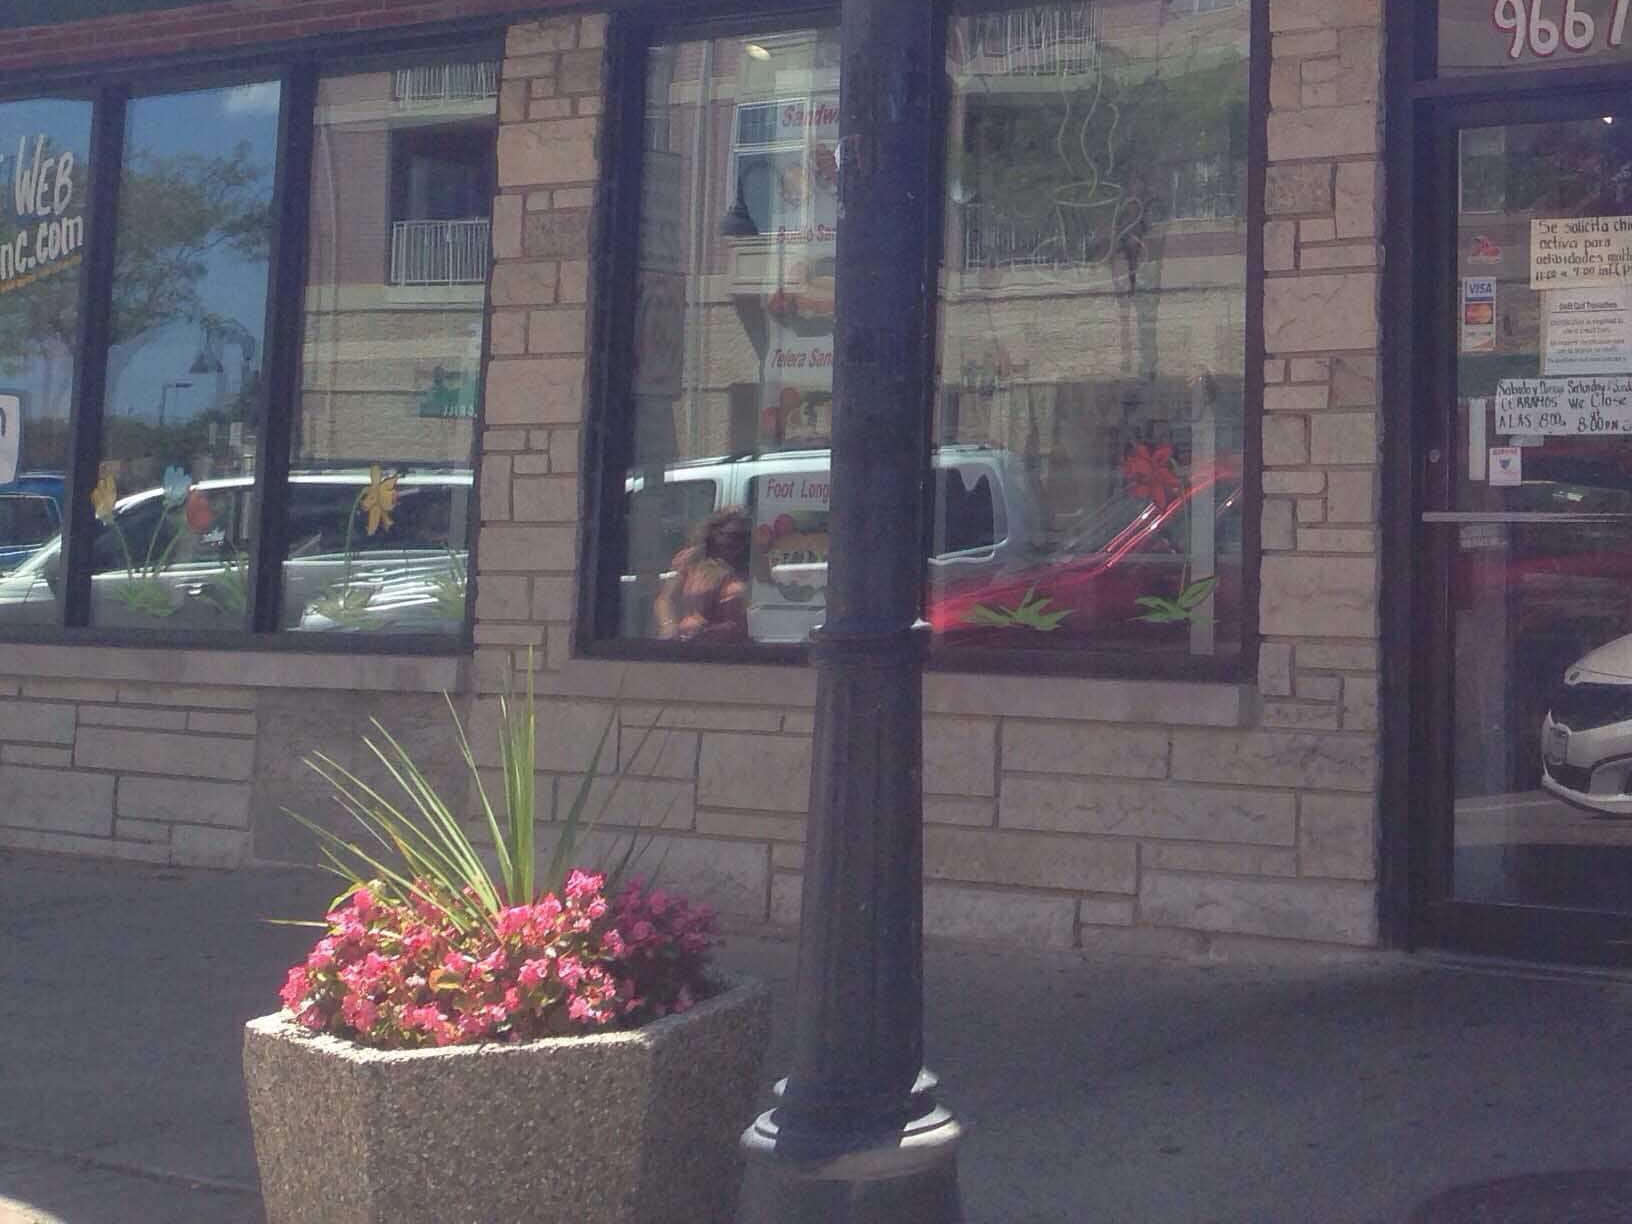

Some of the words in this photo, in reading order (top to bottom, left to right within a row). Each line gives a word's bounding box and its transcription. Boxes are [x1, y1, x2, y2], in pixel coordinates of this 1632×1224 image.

[1584, 238, 1611, 255] para
[1470, 282, 1492, 295] VISA
[766, 477, 795, 499] Foot
